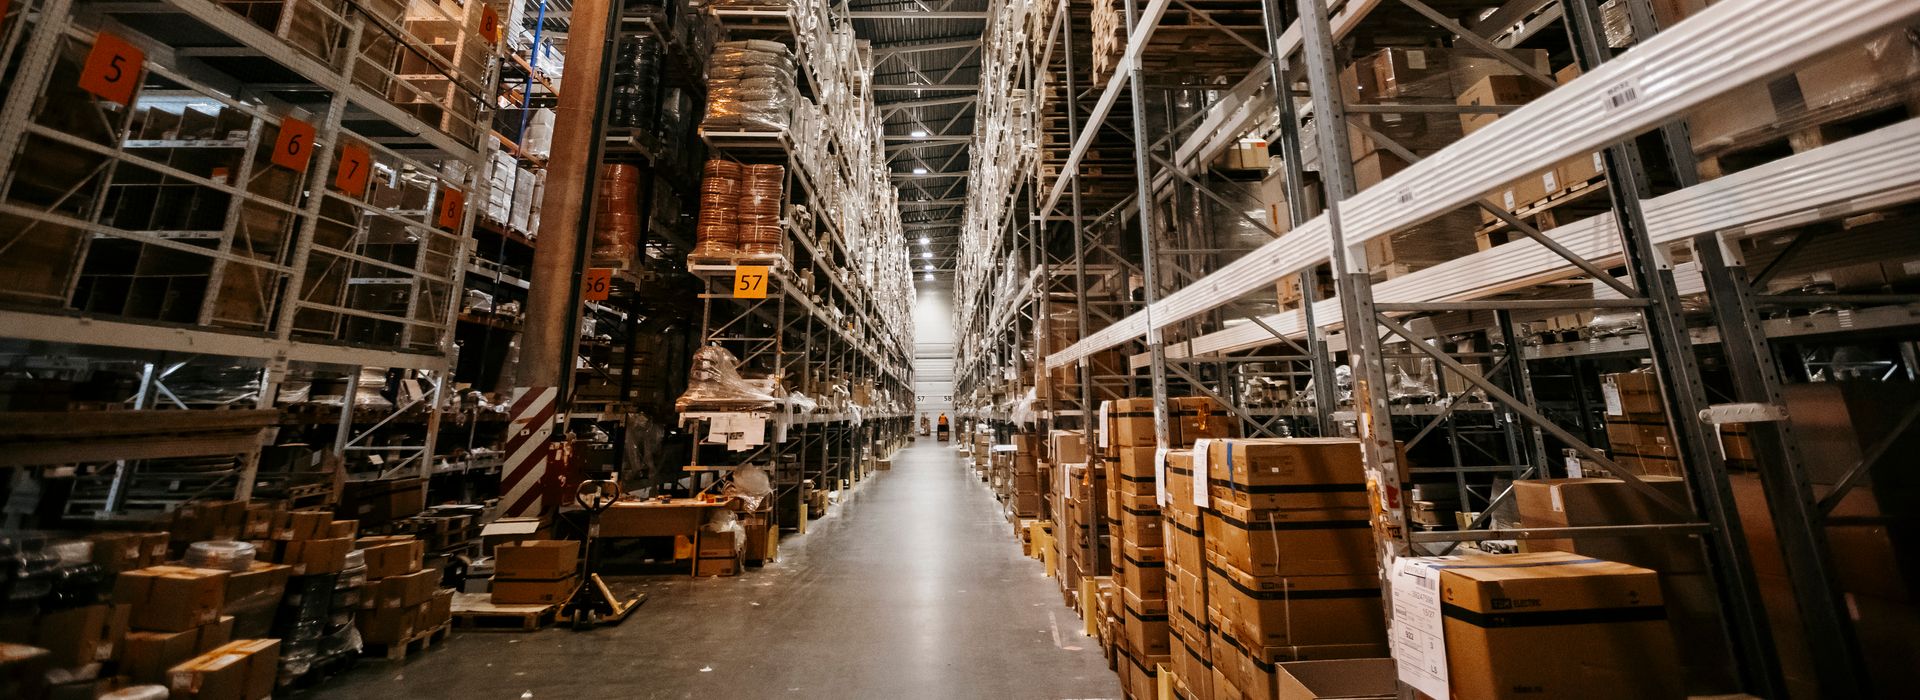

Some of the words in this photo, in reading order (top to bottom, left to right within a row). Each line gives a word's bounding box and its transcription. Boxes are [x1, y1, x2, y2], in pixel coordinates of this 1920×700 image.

[486, 16, 492, 31] 8
[104, 54, 126, 82] 5
[288, 134, 302, 155] 6
[348, 160, 359, 179] 7
[448, 201, 456, 218] 8
[587, 277, 605, 292] 56
[740, 275, 762, 290] 57
